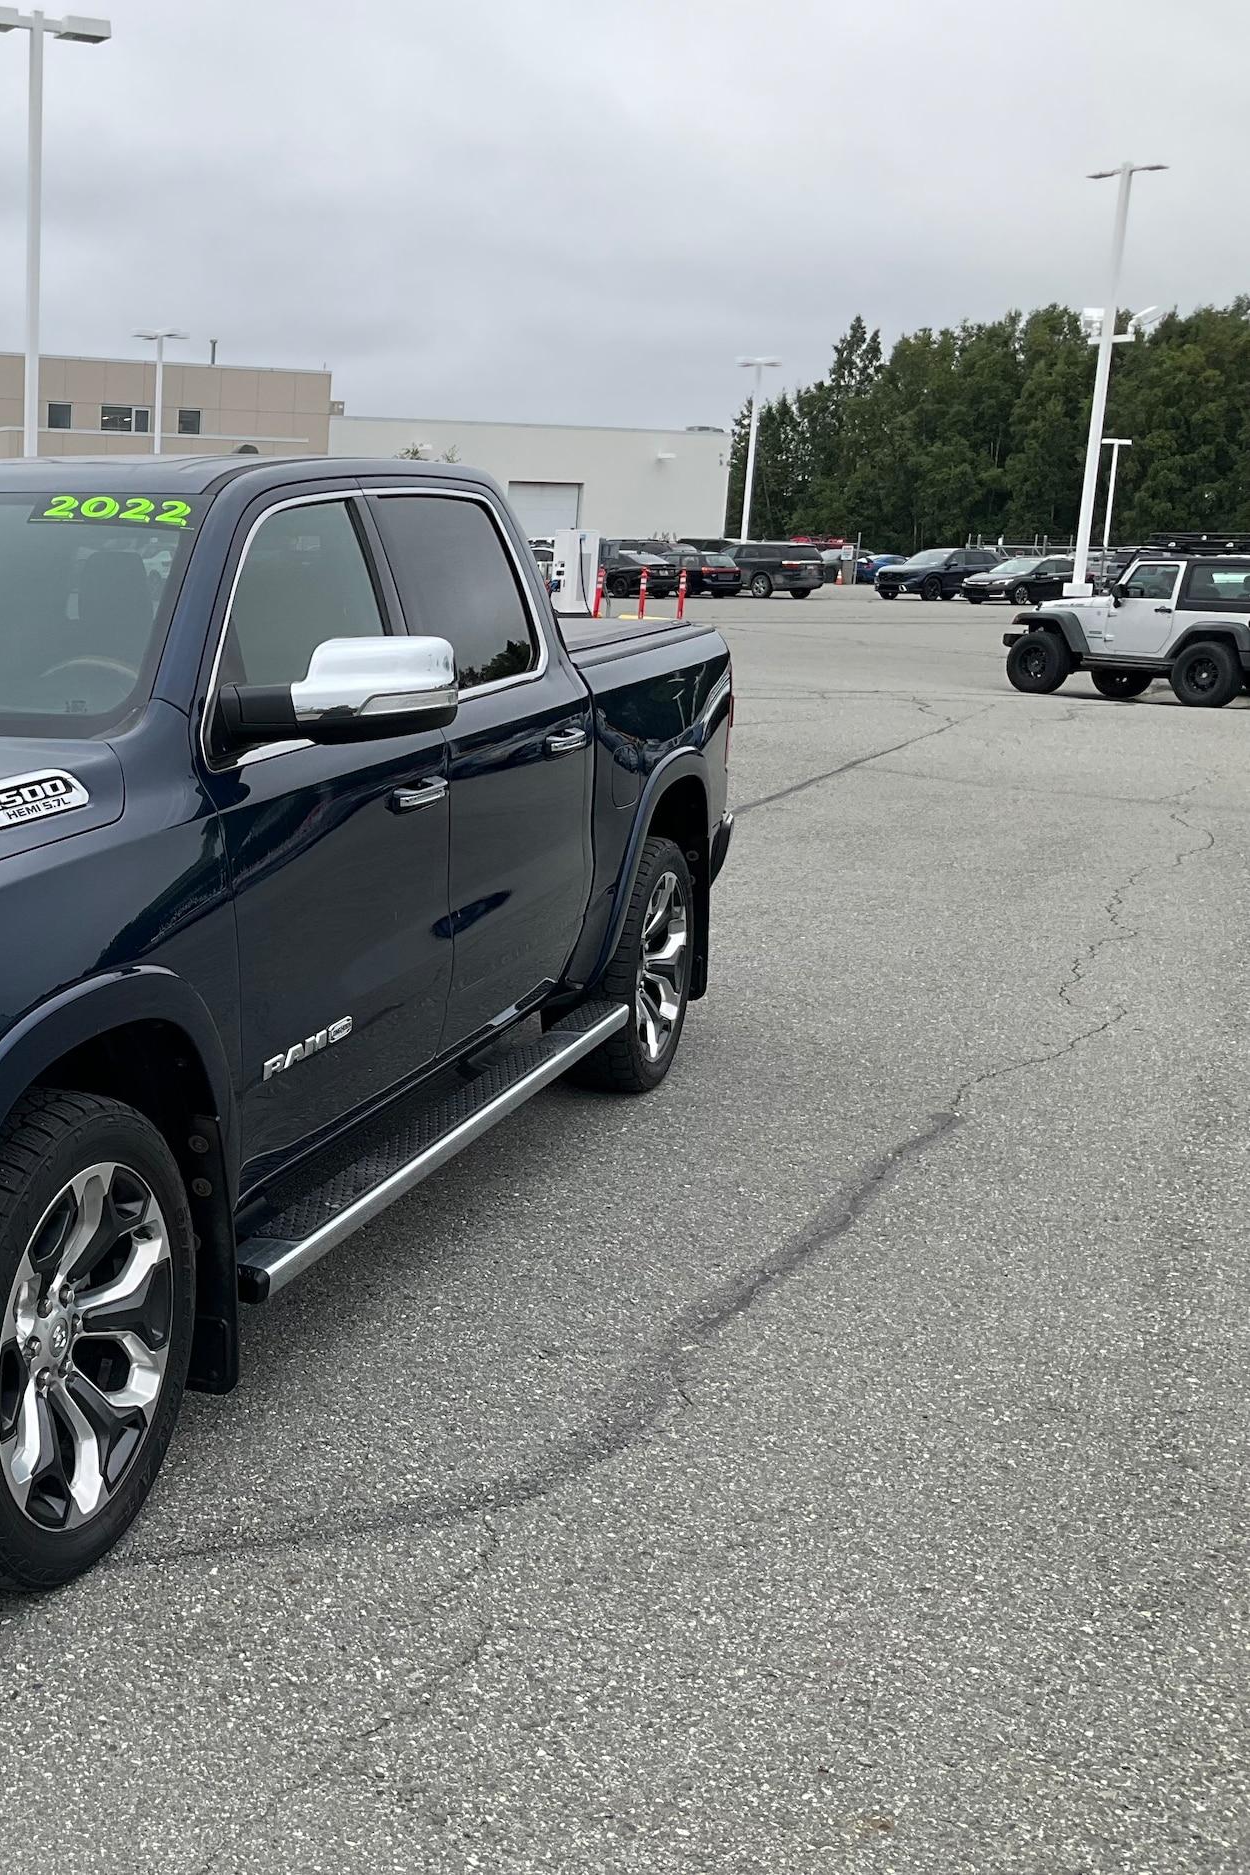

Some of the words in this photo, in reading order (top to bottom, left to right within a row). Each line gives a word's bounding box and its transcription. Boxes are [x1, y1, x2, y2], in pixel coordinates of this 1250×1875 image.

[43, 495, 192, 527] 2022
[6, 804, 41, 820] HEMI
[44, 797, 71, 810] 5.7L
[263, 1029, 328, 1081] RAM
